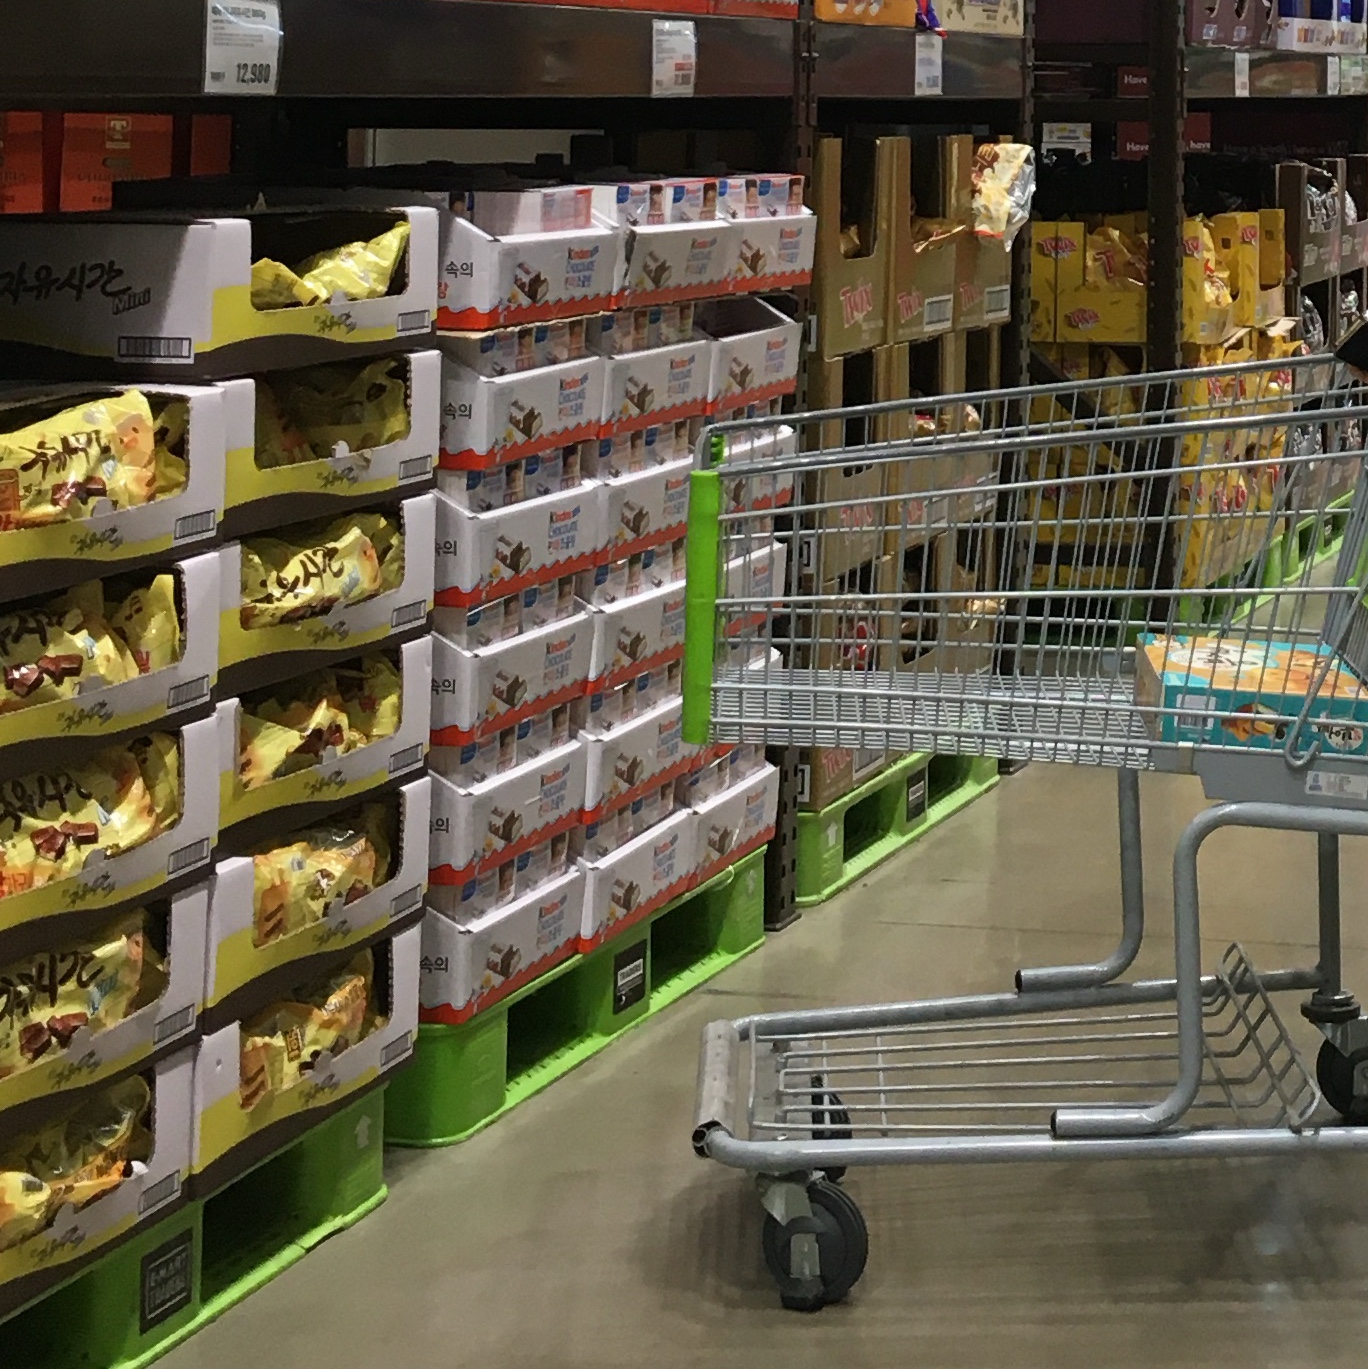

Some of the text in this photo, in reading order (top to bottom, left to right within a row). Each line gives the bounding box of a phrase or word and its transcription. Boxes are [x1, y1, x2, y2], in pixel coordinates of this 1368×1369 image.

[1124, 74, 1148, 84] Have
[445, 261, 473, 278] 속의
[0, 259, 132, 305] 자유시간
[112, 287, 151, 316] Mini
[443, 402, 472, 420] 속의
